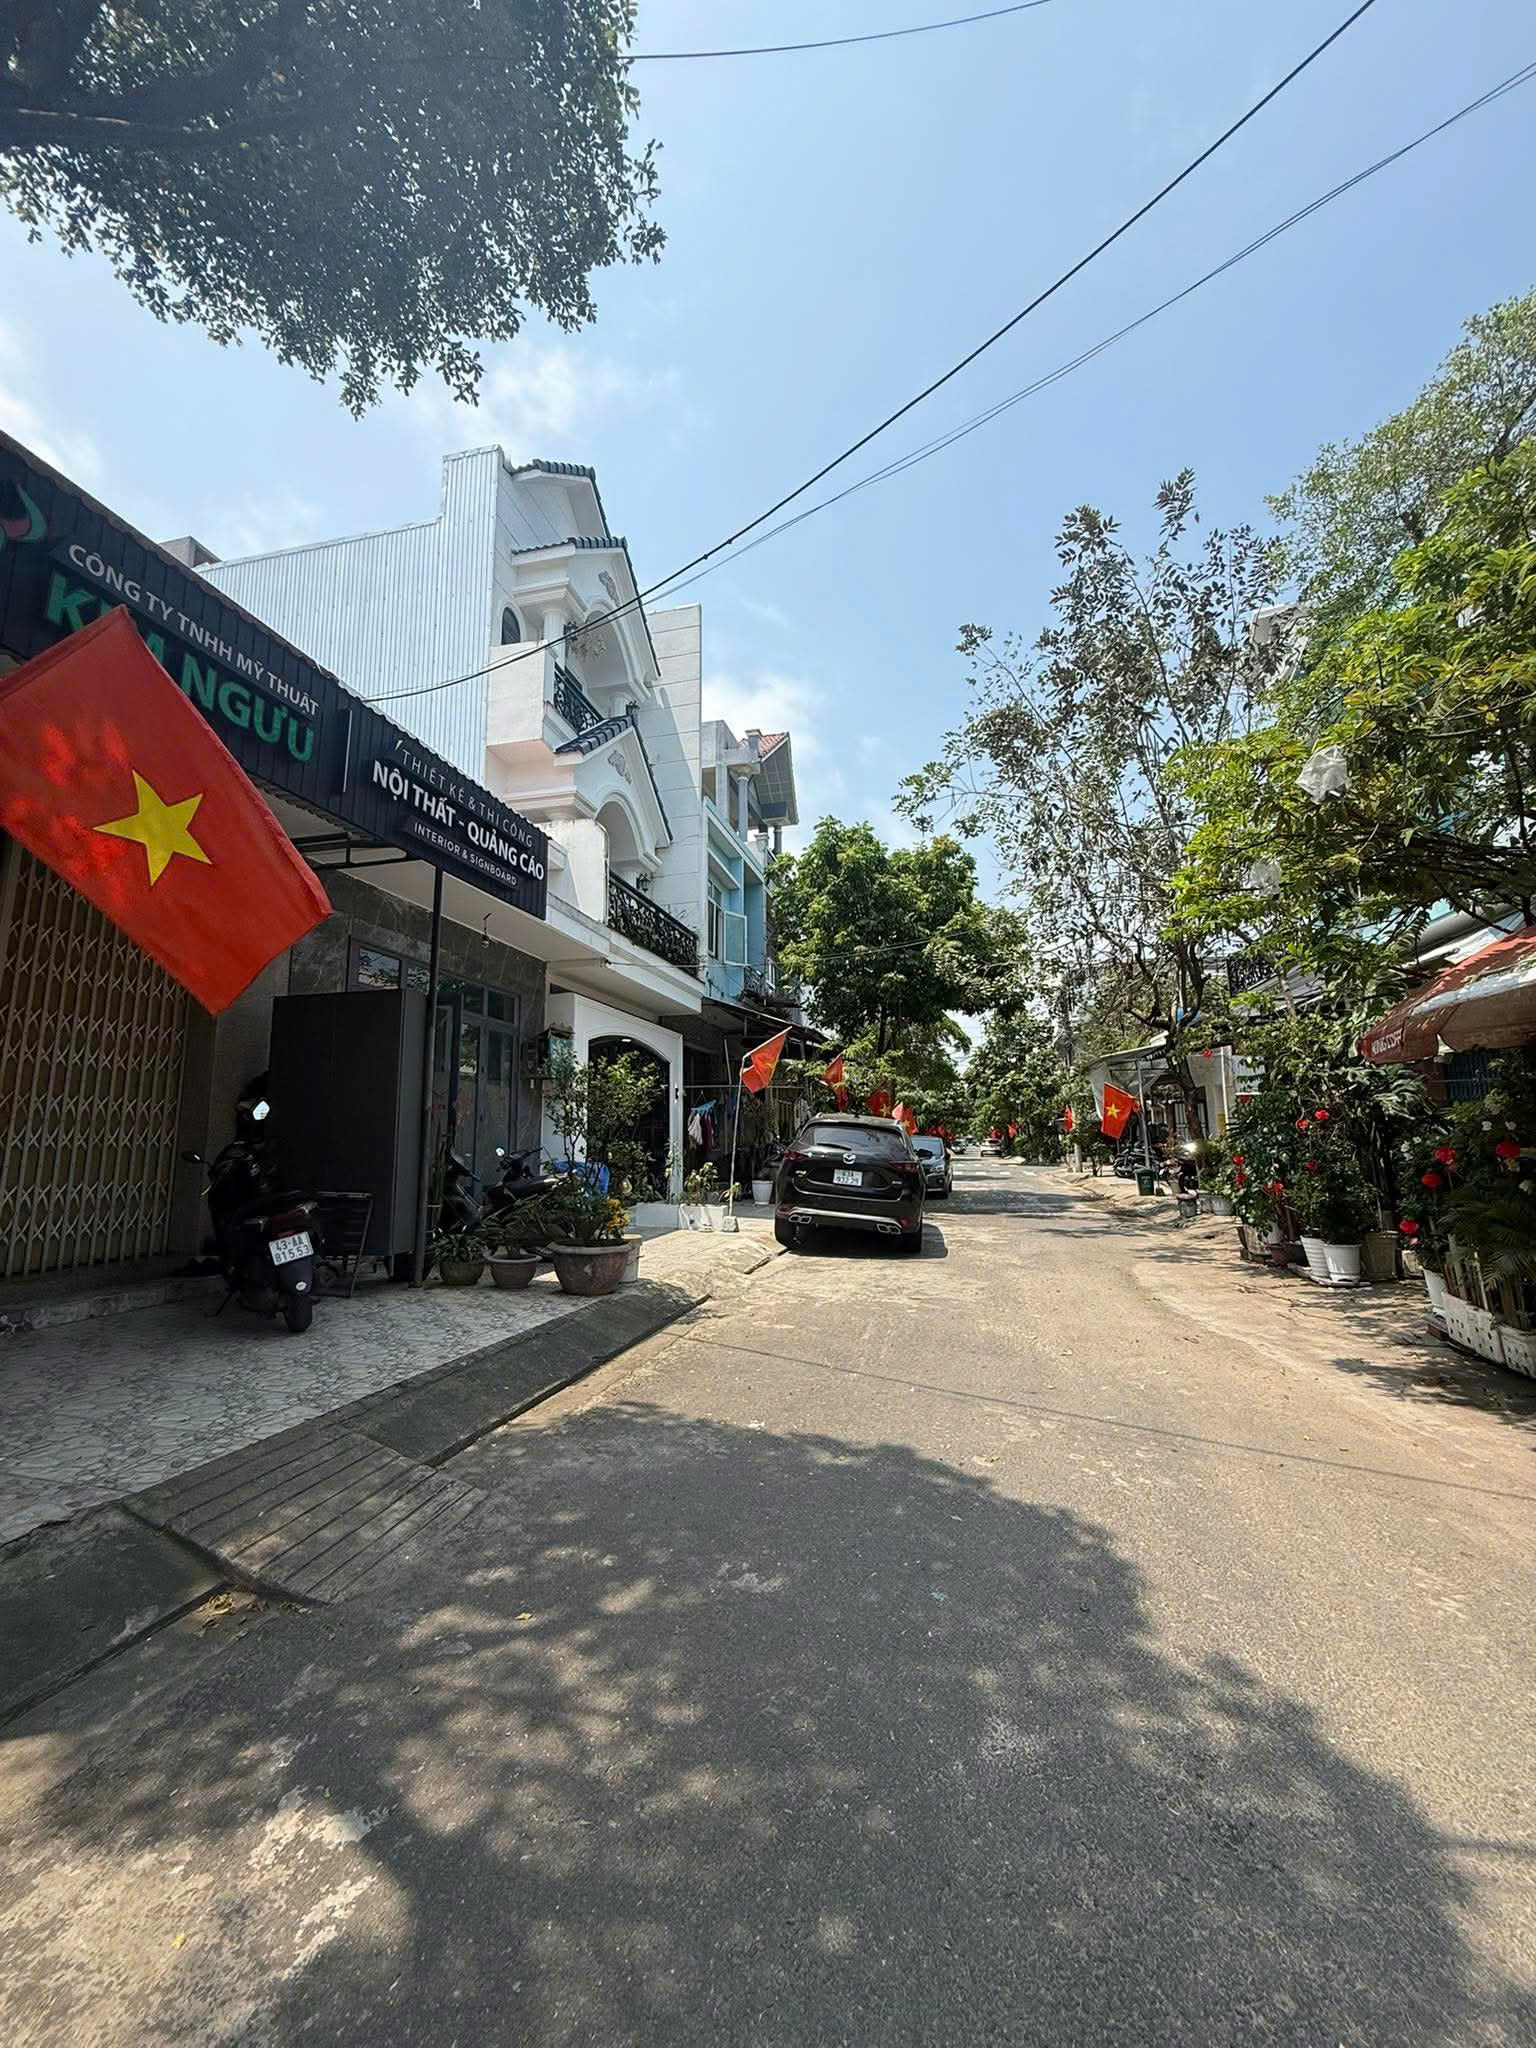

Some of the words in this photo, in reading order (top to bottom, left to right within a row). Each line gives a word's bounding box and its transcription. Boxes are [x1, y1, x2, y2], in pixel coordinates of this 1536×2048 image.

[69, 543, 141, 602] CÔNG
[146, 591, 174, 621] TY
[177, 612, 233, 662] TNHH
[236, 652, 265, 681] MỸ
[267, 671, 319, 716] THUẬT
[373, 759, 409, 801] NỘI
[412, 783, 456, 828] THẤT
[467, 821, 518, 867] QUẢNG
[520, 853, 544, 881] CÁO
[414, 822, 460, 856] INTERIOR
[462, 849, 468, 859] &
[470, 854, 518, 886] SIGNBOARD
[468, 796, 476, 811] &
[480, 802, 500, 826] THI
